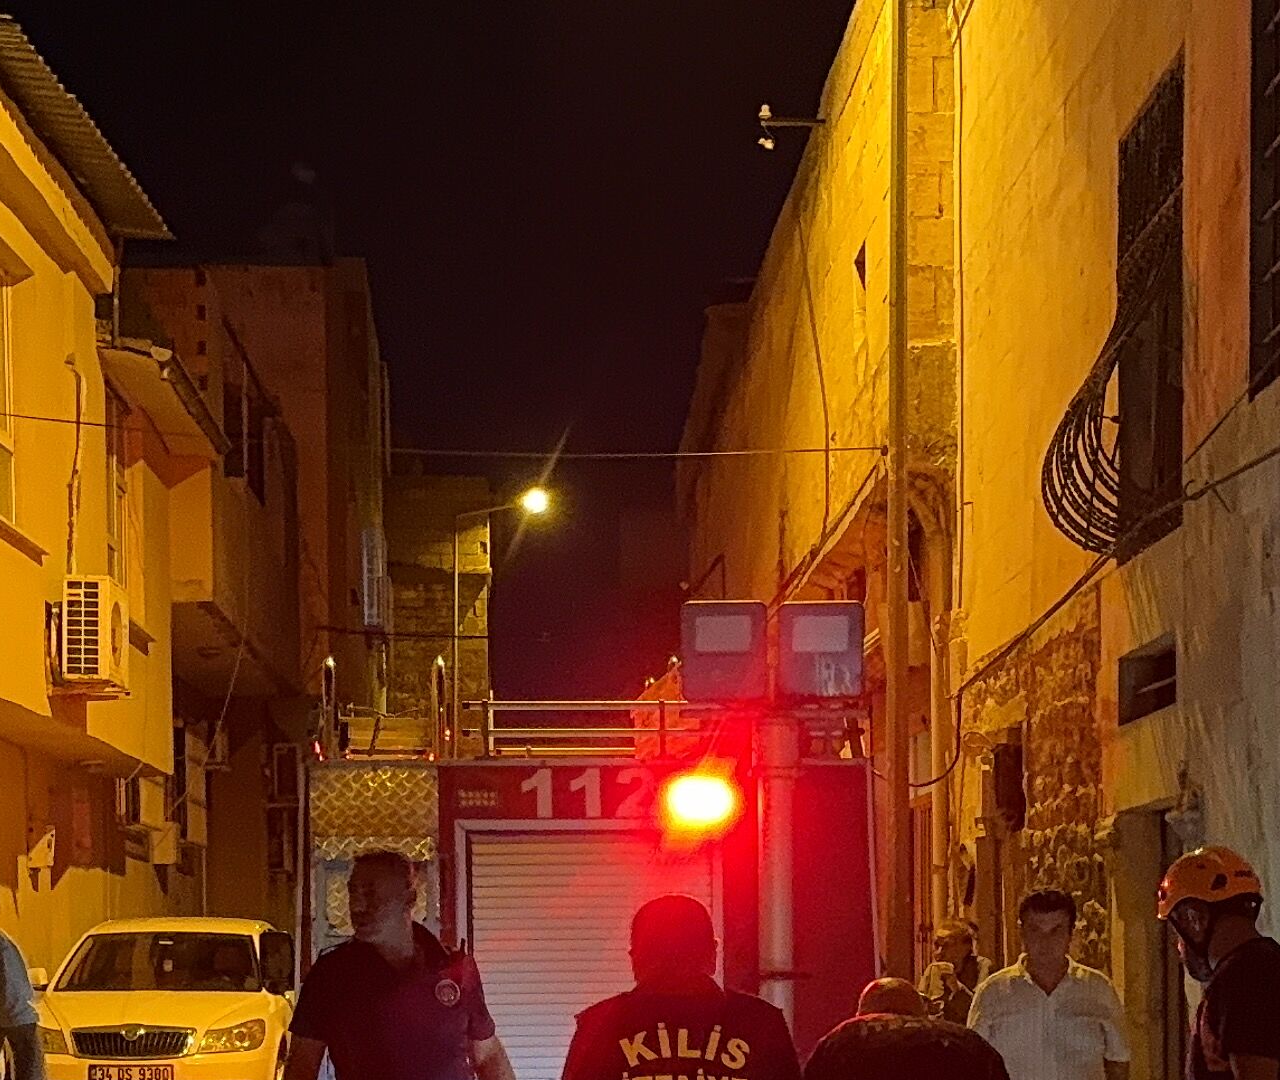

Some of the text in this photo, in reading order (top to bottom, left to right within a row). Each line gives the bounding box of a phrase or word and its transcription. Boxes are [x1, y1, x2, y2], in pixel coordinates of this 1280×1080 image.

[521, 767, 655, 818] 112
[619, 1022, 750, 1069] KİLİS
[98, 1067, 112, 1080] 34
